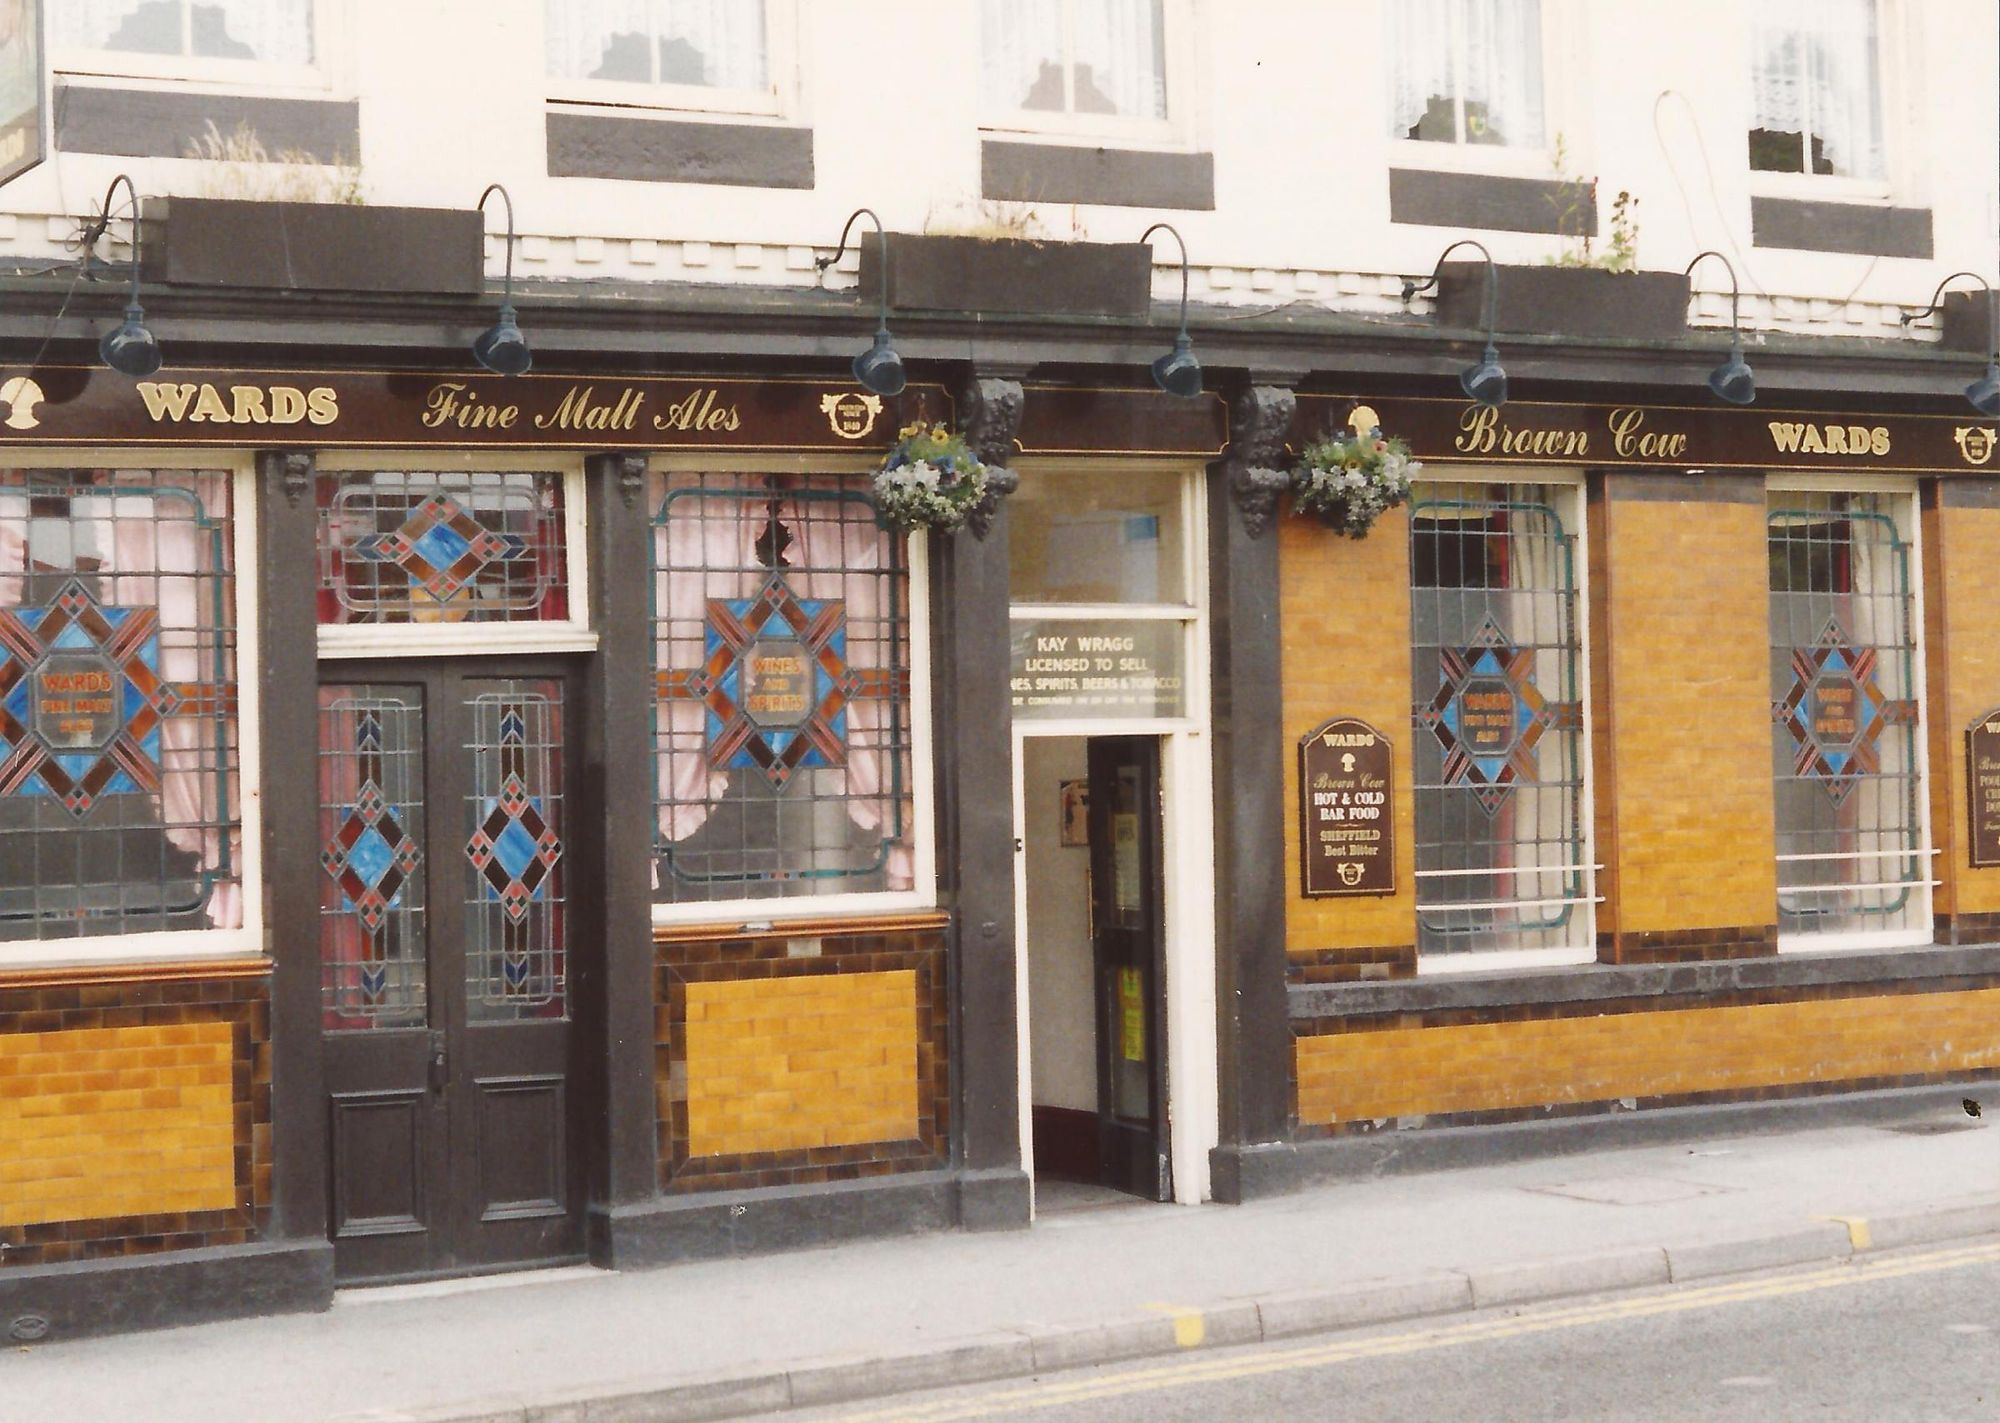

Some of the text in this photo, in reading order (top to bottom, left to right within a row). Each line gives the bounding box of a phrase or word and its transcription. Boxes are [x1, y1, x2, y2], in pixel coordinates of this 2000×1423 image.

[136, 382, 338, 425] WARDS
[421, 383, 741, 431] Fine Malt Ales
[1455, 405, 1687, 457] Brown Cow
[1768, 421, 1890, 456] WARDS
[1037, 637, 1134, 652] KAY WRAGG
[752, 656, 801, 674] WINES
[1025, 658, 1148, 672] LICENSED TO SELL
[40, 671, 113, 693] WARDS
[1082, 677, 1118, 690] BEERS
[1323, 734, 1375, 747] WARDS
[1313, 772, 1355, 789] Brown
[1314, 791, 1385, 806] HOT & COLD
[1320, 807, 1380, 821] BAR FOOD
[1320, 830, 1381, 842] SHEFFIELD
[1324, 844, 1379, 857] Best Bitter
